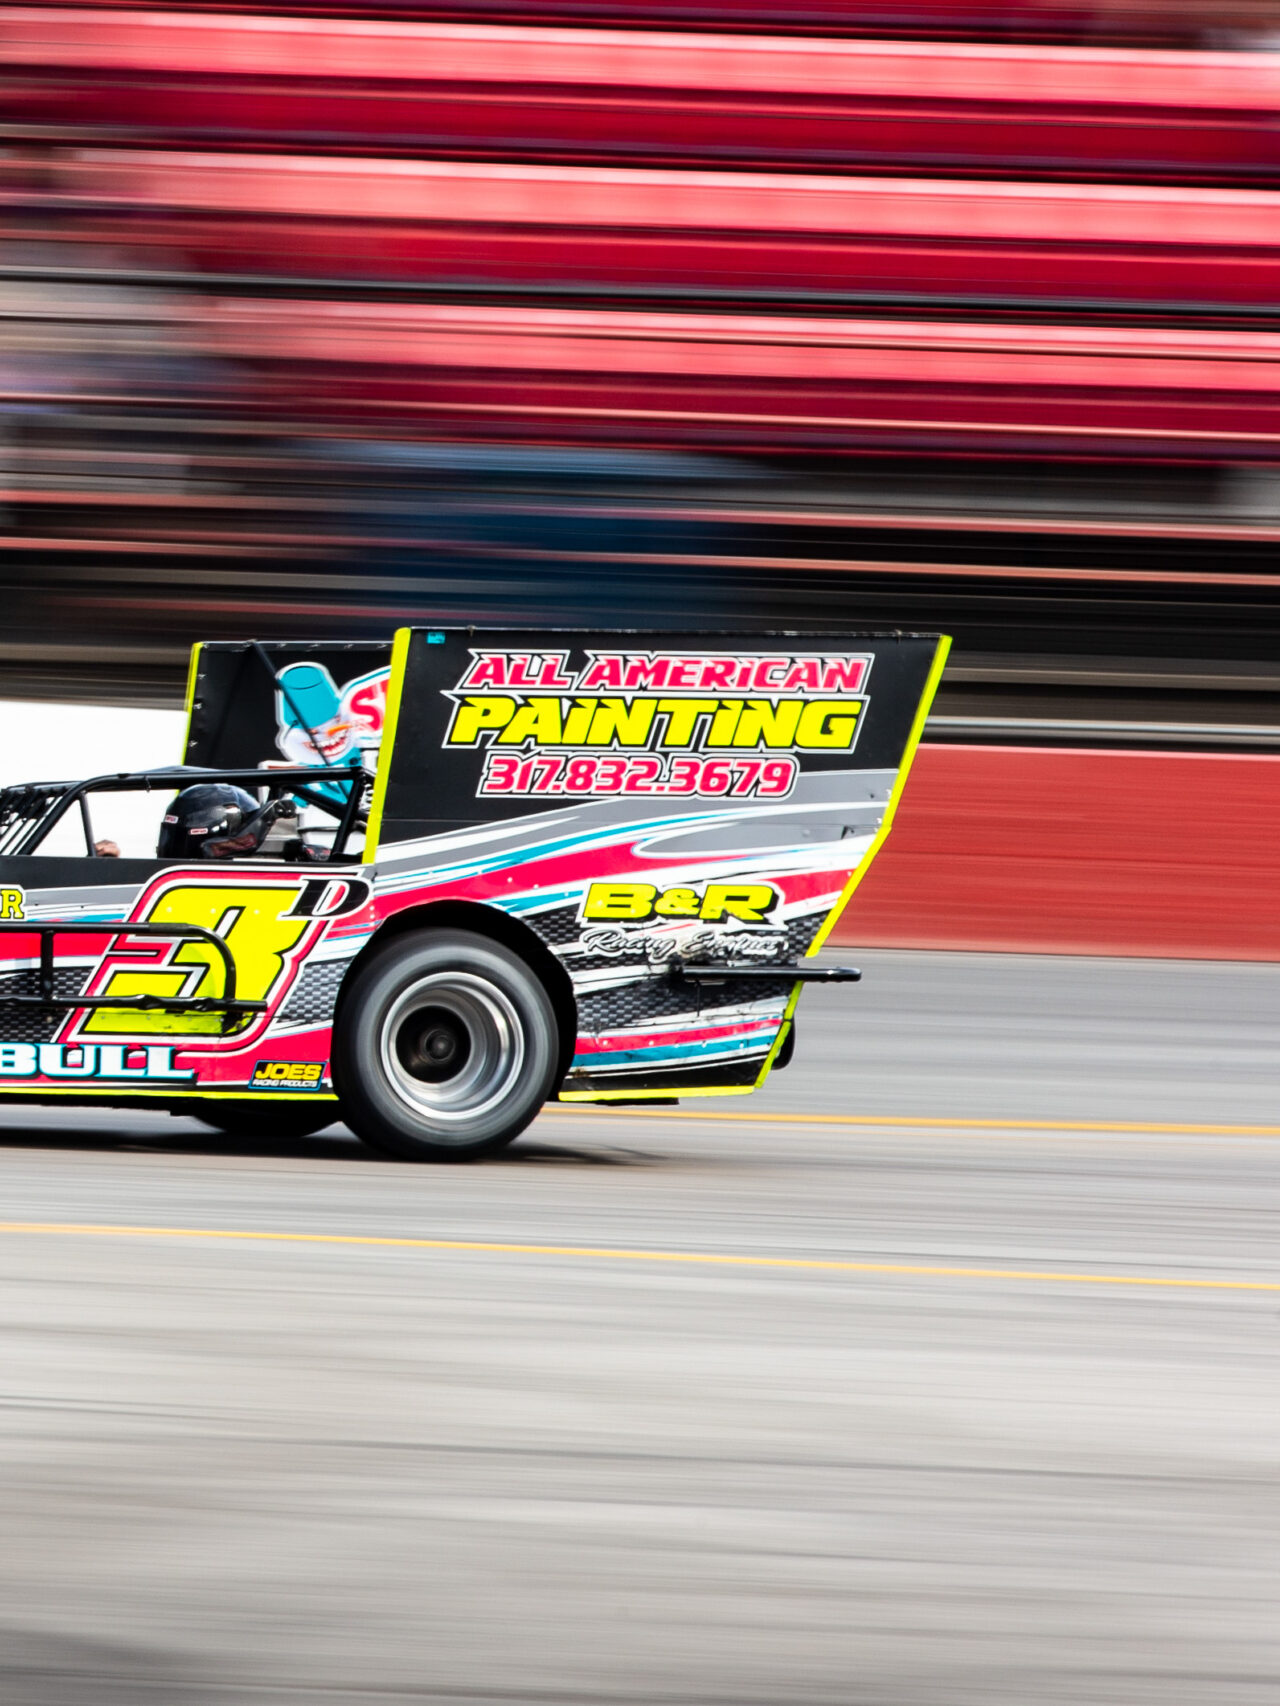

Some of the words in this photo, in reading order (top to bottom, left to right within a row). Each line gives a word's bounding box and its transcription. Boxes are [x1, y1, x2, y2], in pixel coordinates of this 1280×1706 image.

[467, 652, 573, 690] ALL
[579, 653, 867, 694] AMERICAN
[449, 695, 865, 750] PAINTING
[483, 755, 796, 795] 317.832.3679
[583, 883, 777, 924] B&R
[582, 929, 678, 963] Racing
[255, 1063, 322, 1080] JOES
